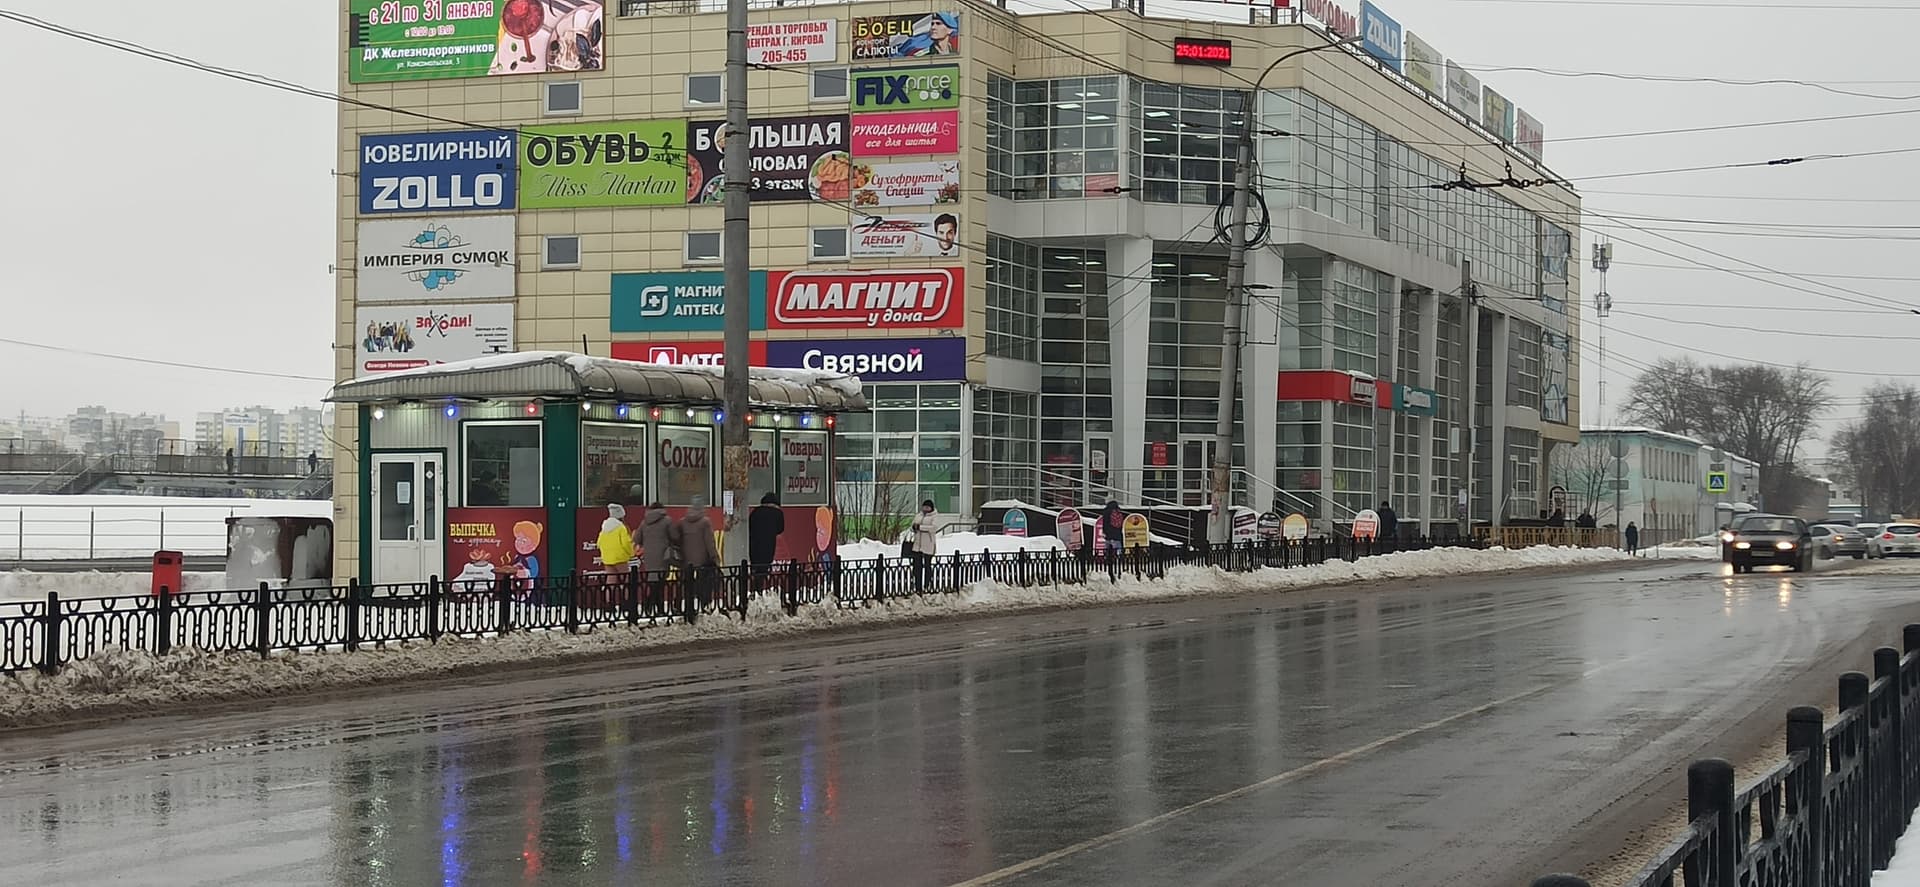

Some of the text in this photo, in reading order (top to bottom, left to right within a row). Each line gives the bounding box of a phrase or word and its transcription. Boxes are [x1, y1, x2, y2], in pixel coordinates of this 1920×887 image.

[381, 1, 400, 24] 21
[402, 5, 419, 23] по
[424, 0, 442, 20] 31
[447, 1, 494, 20] ЯНВАРЯ
[746, 22, 828, 36] РЕНДА В ТОРГОВЫХ
[856, 20, 912, 37] БОЕЦ
[1367, 12, 1398, 58] ZOLLO
[791, 34, 824, 46] КИРОВА
[363, 44, 495, 61] ДК Железнодорожников
[762, 49, 807, 63] 205-455
[857, 46, 899, 57] САЛЮТЫ
[1176, 44, 1230, 58] 25:01:2021
[856, 75, 952, 106] FIX price
[853, 121, 938, 136] РУКОДЕЛЬНИЦА
[662, 131, 673, 150] 2
[866, 137, 937, 148] все для шитья
[365, 135, 512, 164] ЮВЕЛИРНЫЙ
[527, 131, 651, 168] ОБУВЬ
[538, 174, 588, 197] Miss
[751, 177, 805, 192] 3 этаж
[871, 174, 944, 188] Сухофрукты
[373, 173, 502, 209] ZOLLO
[886, 185, 925, 198] Специи
[861, 235, 906, 247] ДЕНЬГИ
[364, 251, 509, 267] ИМПЕРИЯ СУМОК
[786, 281, 942, 310] МАГНИТ
[866, 309, 925, 327] у дома
[802, 348, 923, 373] Связной
[588, 448, 608, 465] чай
[661, 438, 707, 469] Соки
[782, 438, 822, 461] Товары
[788, 476, 820, 493] дорогу
[450, 523, 496, 537] ВЫПЕЧКА
